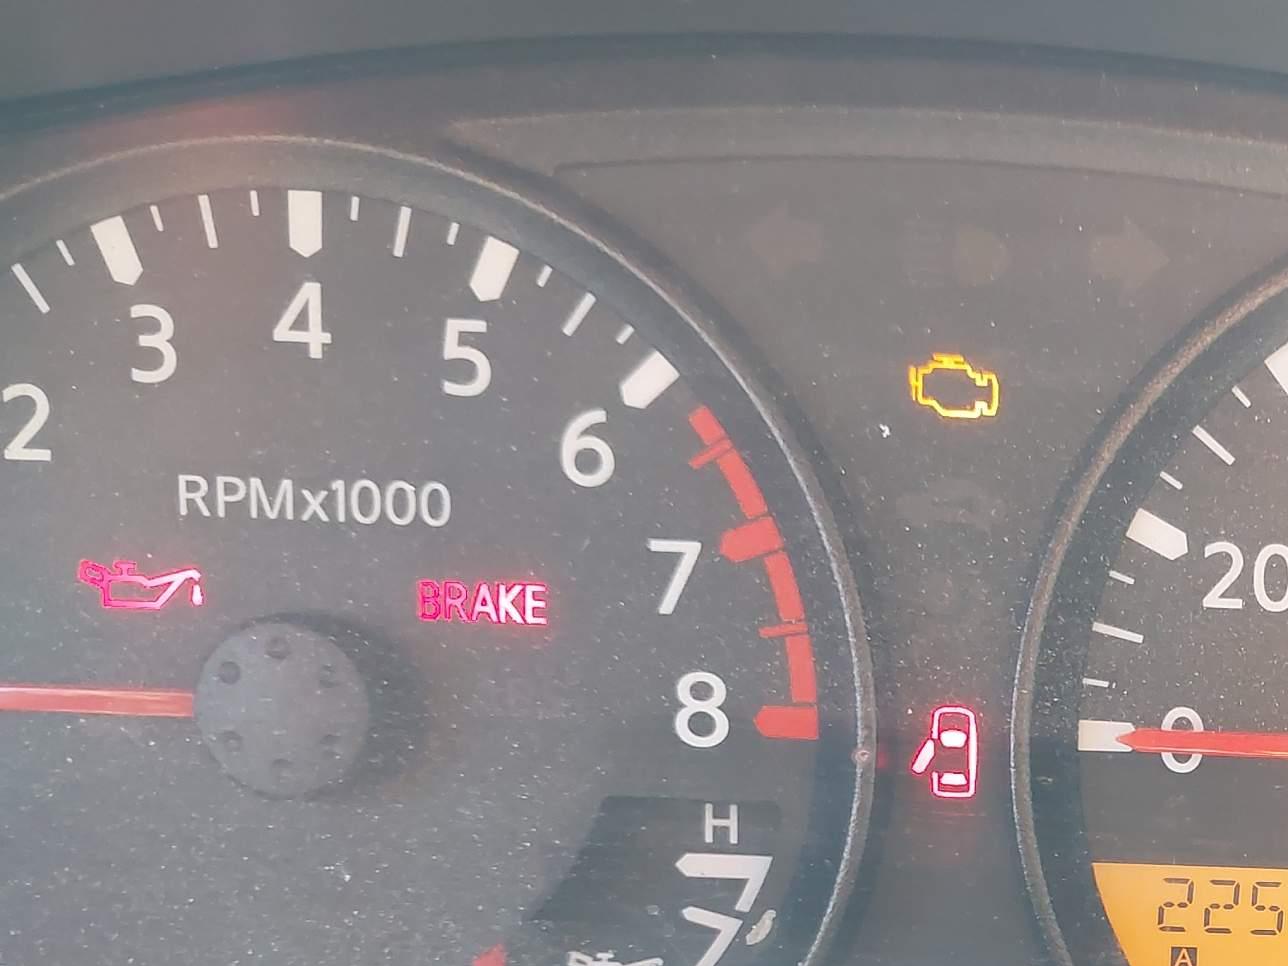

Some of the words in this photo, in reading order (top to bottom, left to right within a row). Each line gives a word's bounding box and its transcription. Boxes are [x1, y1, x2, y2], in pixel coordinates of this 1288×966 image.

[129, 305, 177, 383] 3
[272, 282, 332, 360] 4
[442, 319, 492, 396] 5
[2, 384, 53, 461] 2
[561, 410, 615, 488] 6
[417, 580, 549, 626] BRAKE
[645, 539, 702, 614] 7
[673, 672, 729, 748] 8
[705, 804, 739, 844] H
